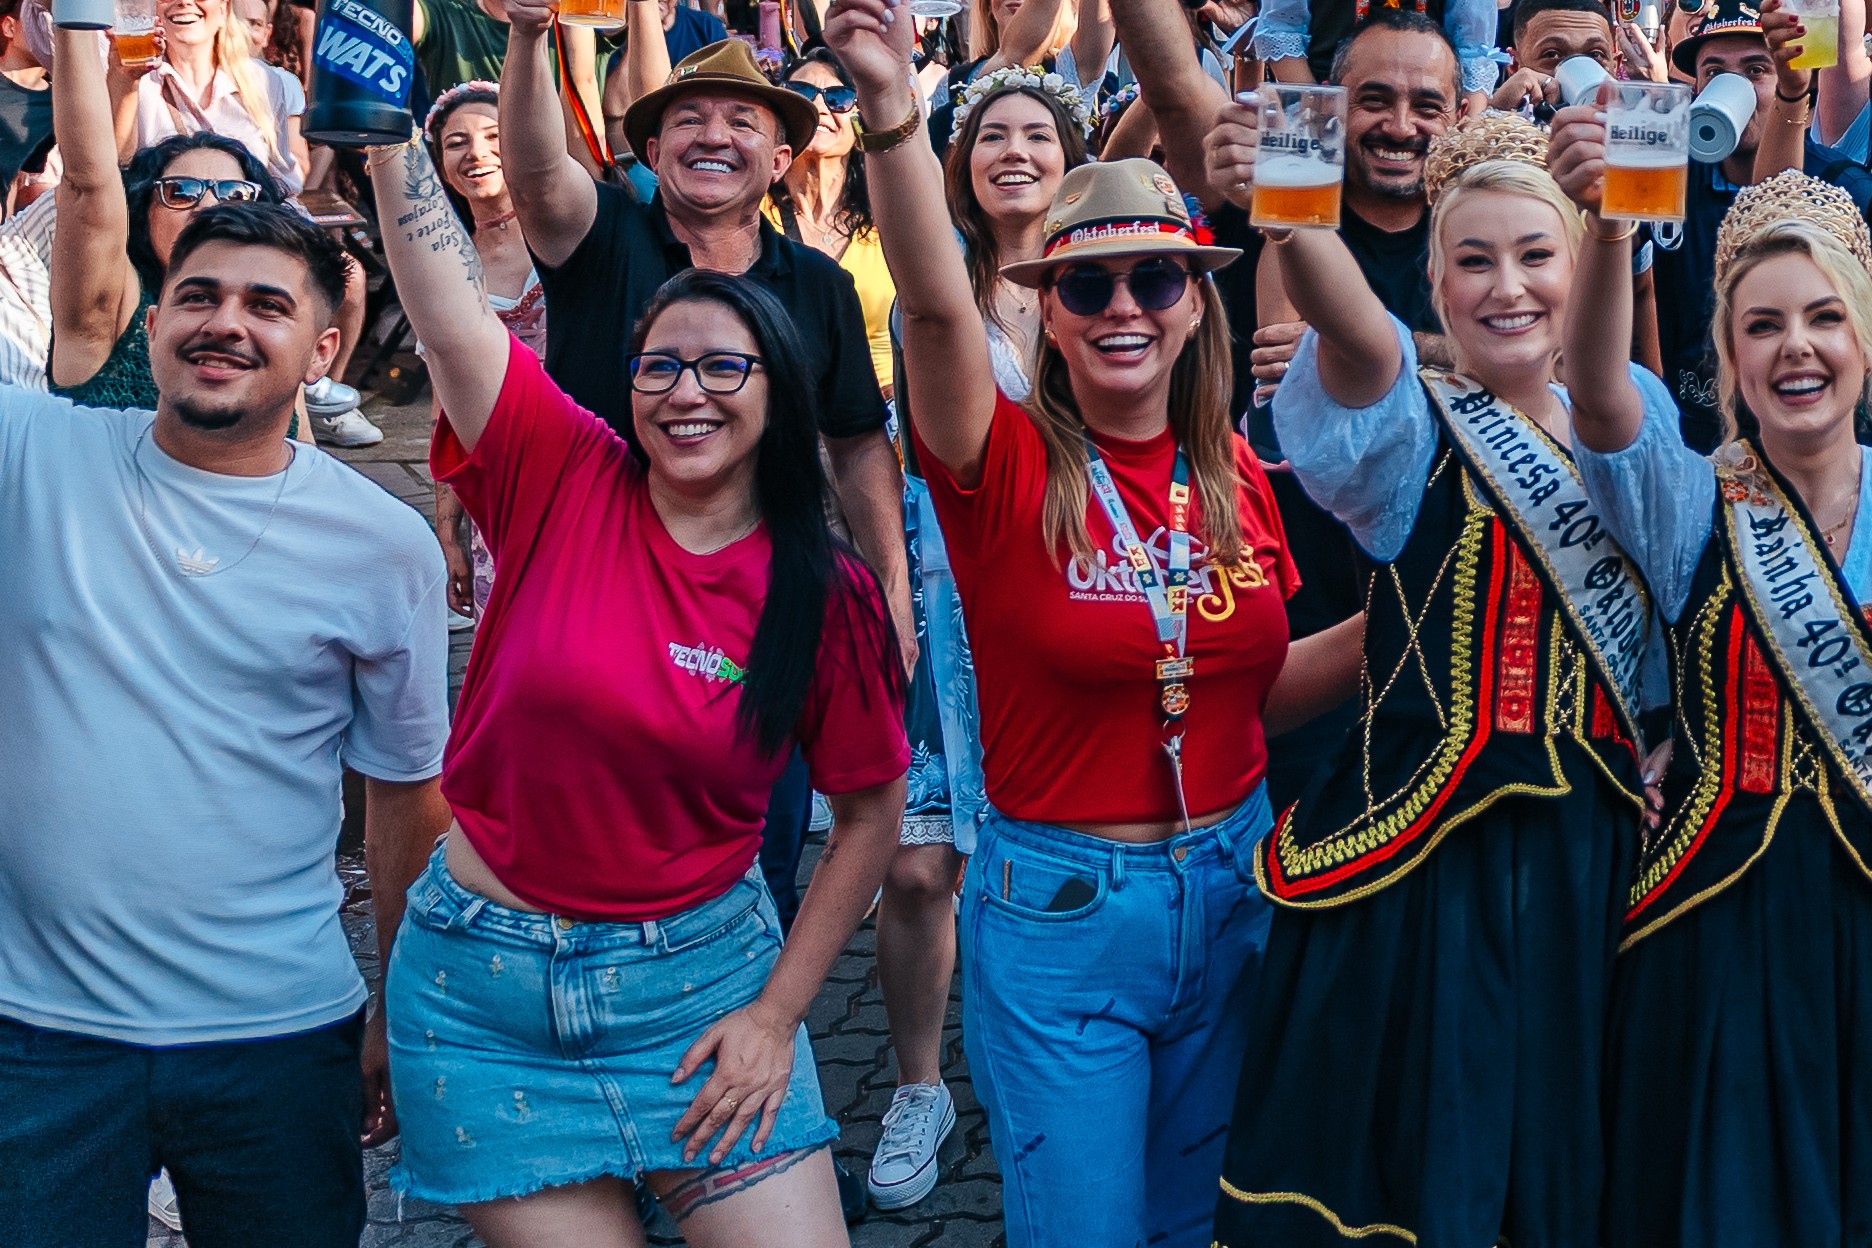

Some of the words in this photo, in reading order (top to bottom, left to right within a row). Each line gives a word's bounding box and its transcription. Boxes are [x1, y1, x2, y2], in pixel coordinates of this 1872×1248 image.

[1610, 125, 1668, 146] Heilige
[1450, 389, 1560, 507] Princesa
[1747, 507, 1815, 620] Rainha
[1069, 590, 1099, 601] SANTA
[1099, 593, 1124, 602] CRUZ
[1125, 594, 1137, 602] DO
[1579, 604, 1609, 652] SANTA
[1838, 738, 1872, 787] SANTA
